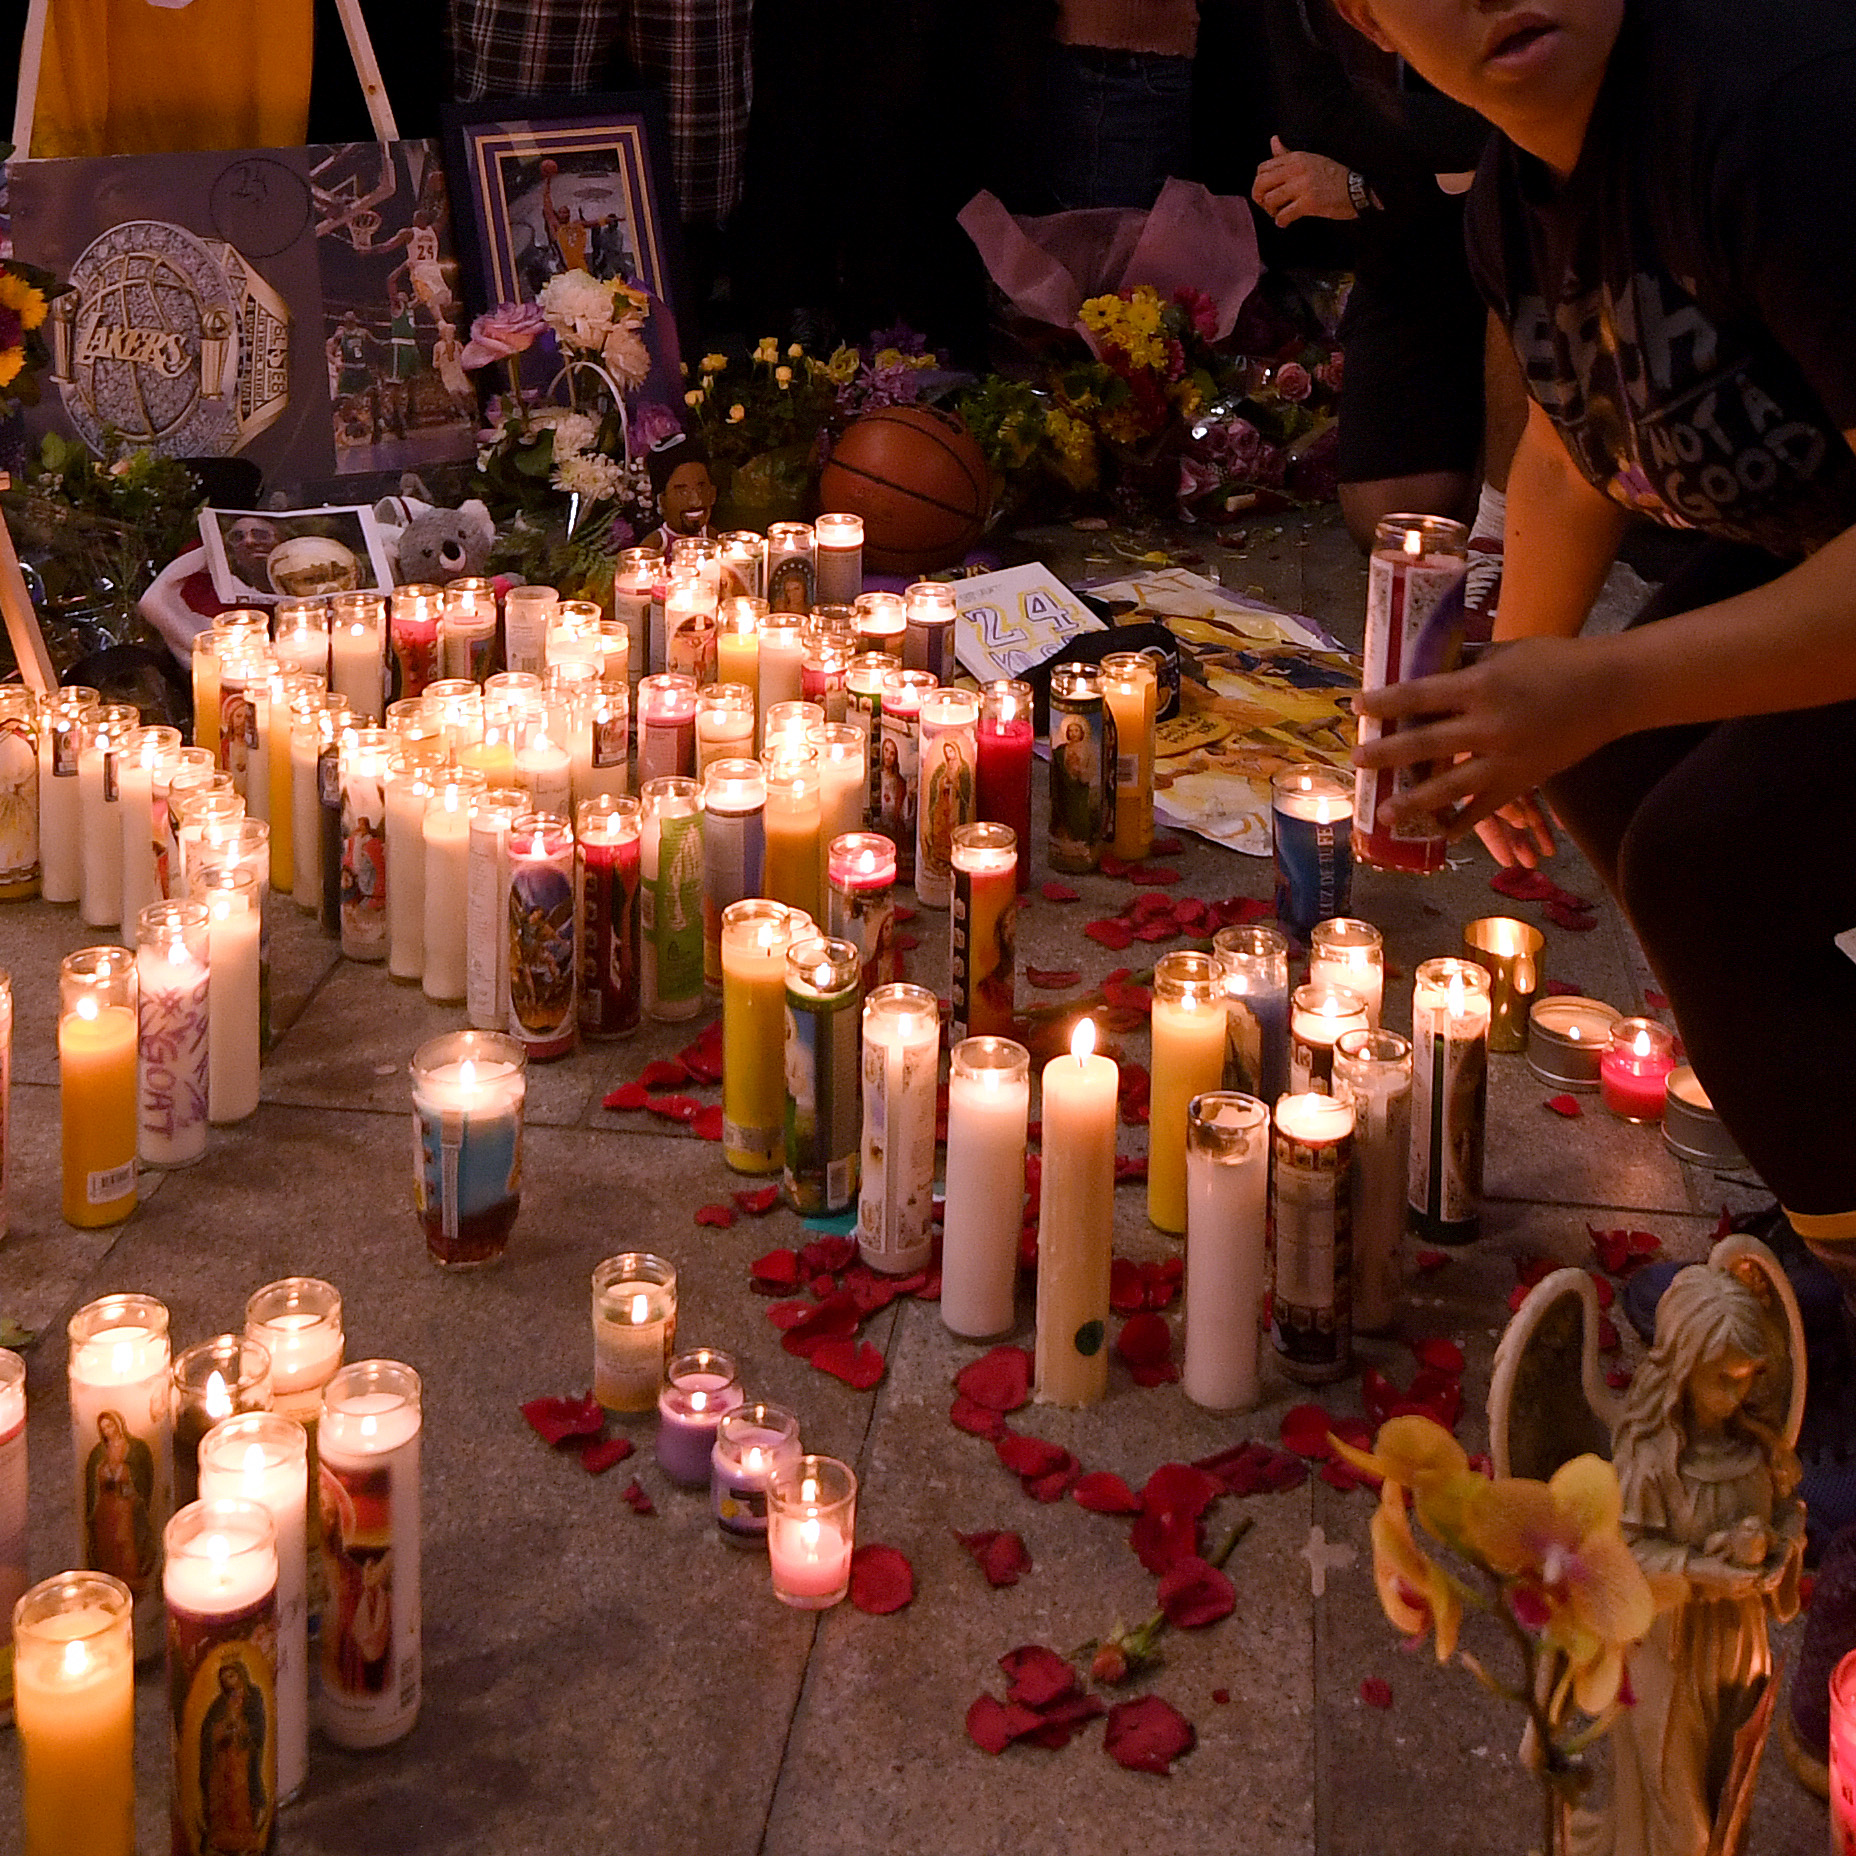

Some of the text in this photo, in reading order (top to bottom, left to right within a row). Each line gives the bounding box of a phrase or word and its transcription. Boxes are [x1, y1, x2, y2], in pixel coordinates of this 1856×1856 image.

[416, 243, 435, 261] 24
[72, 310, 193, 379] LAKERS
[1648, 372, 1784, 470] NOT A
[1664, 421, 1827, 521] GOOD
[965, 590, 1081, 648] 24
